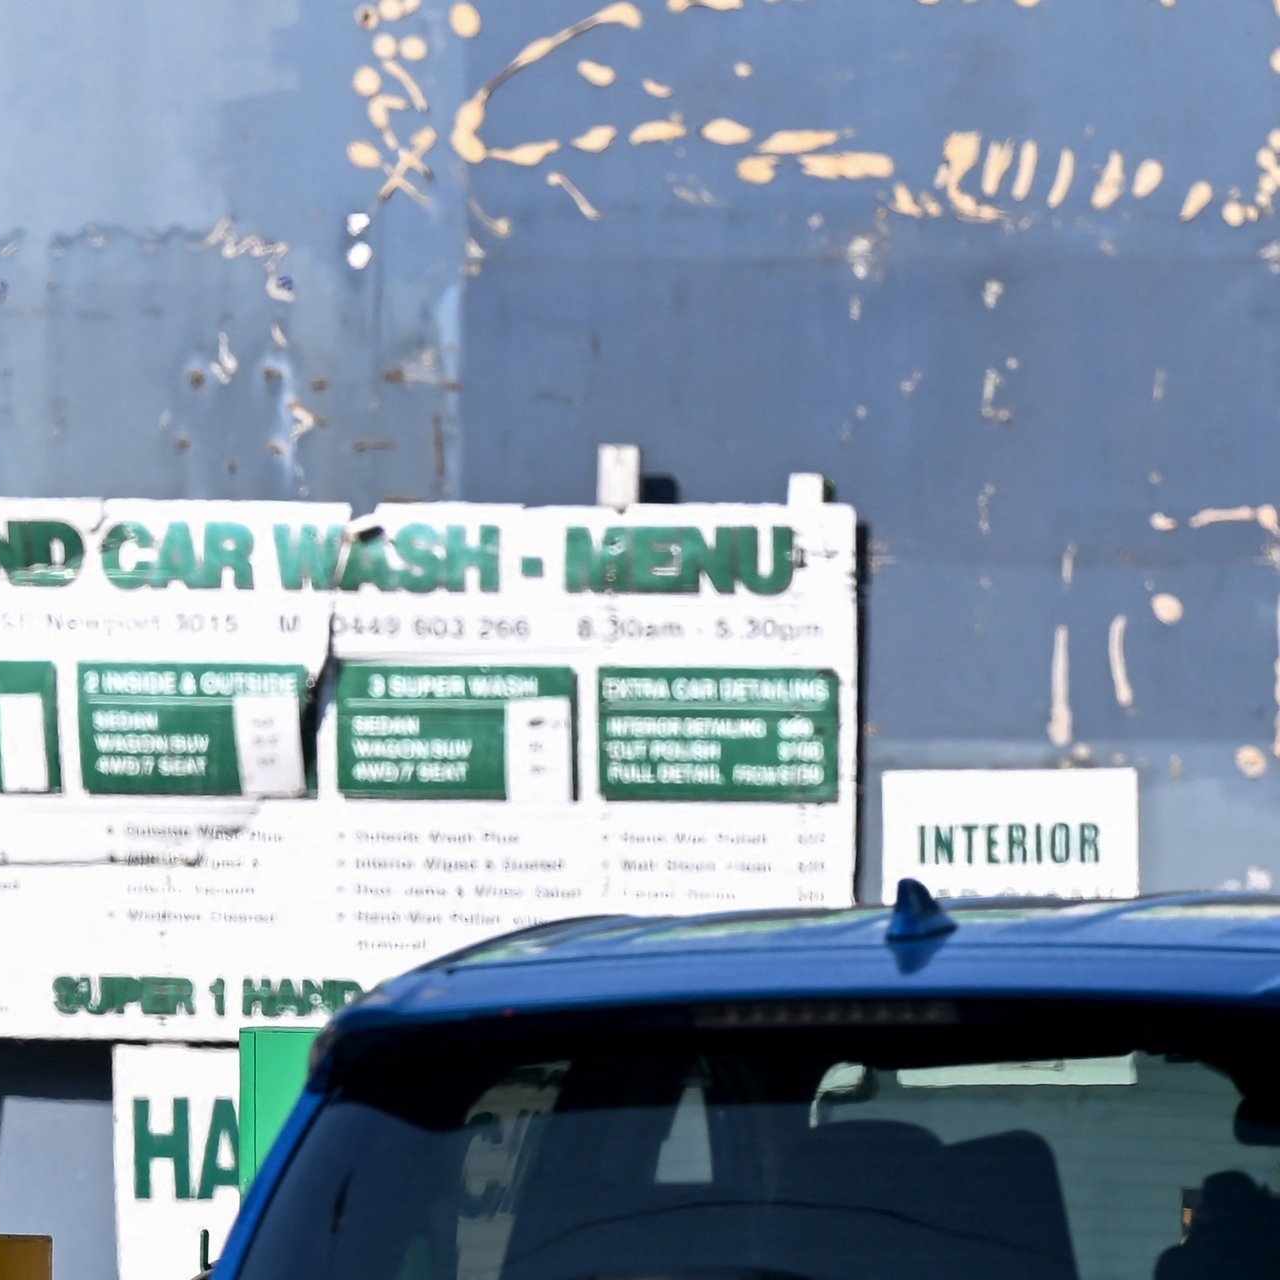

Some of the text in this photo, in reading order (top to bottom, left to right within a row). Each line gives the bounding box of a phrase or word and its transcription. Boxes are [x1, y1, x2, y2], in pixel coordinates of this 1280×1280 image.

[101, 521, 254, 589] CAR
[274, 523, 500, 592] WASH
[564, 526, 795, 595] MENU
[102, 671, 177, 695] INSIDE
[199, 671, 298, 696] OUTSIDE
[387, 674, 466, 698] SUPER
[917, 821, 1101, 865] INTERIOR
[52, 976, 362, 1017] SUPER 1 HAND
[133, 1096, 240, 1201] HA
